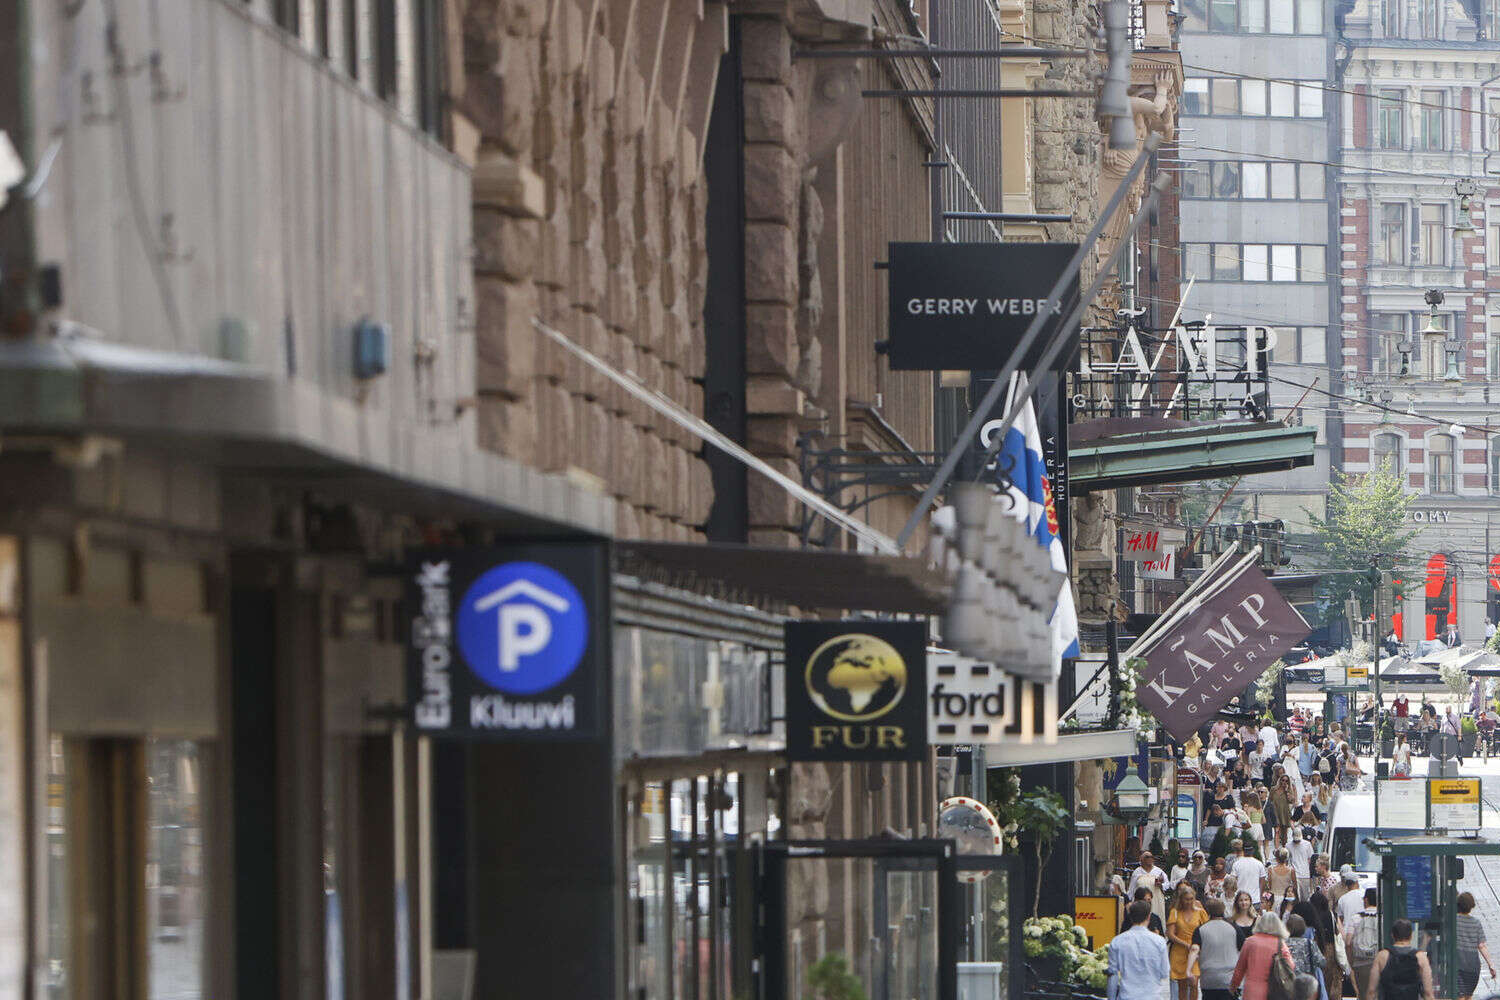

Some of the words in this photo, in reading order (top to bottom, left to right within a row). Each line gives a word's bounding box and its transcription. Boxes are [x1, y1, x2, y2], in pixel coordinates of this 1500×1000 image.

[908, 298, 978, 315] GERRY
[1073, 393, 1257, 409] GALLERIA
[1057, 462, 1065, 501] HOTEL
[1127, 531, 1159, 552] H&M
[1187, 634, 1280, 715] GALLERIA
[470, 694, 575, 730] Kluuvi
[811, 726, 908, 748] FUR
